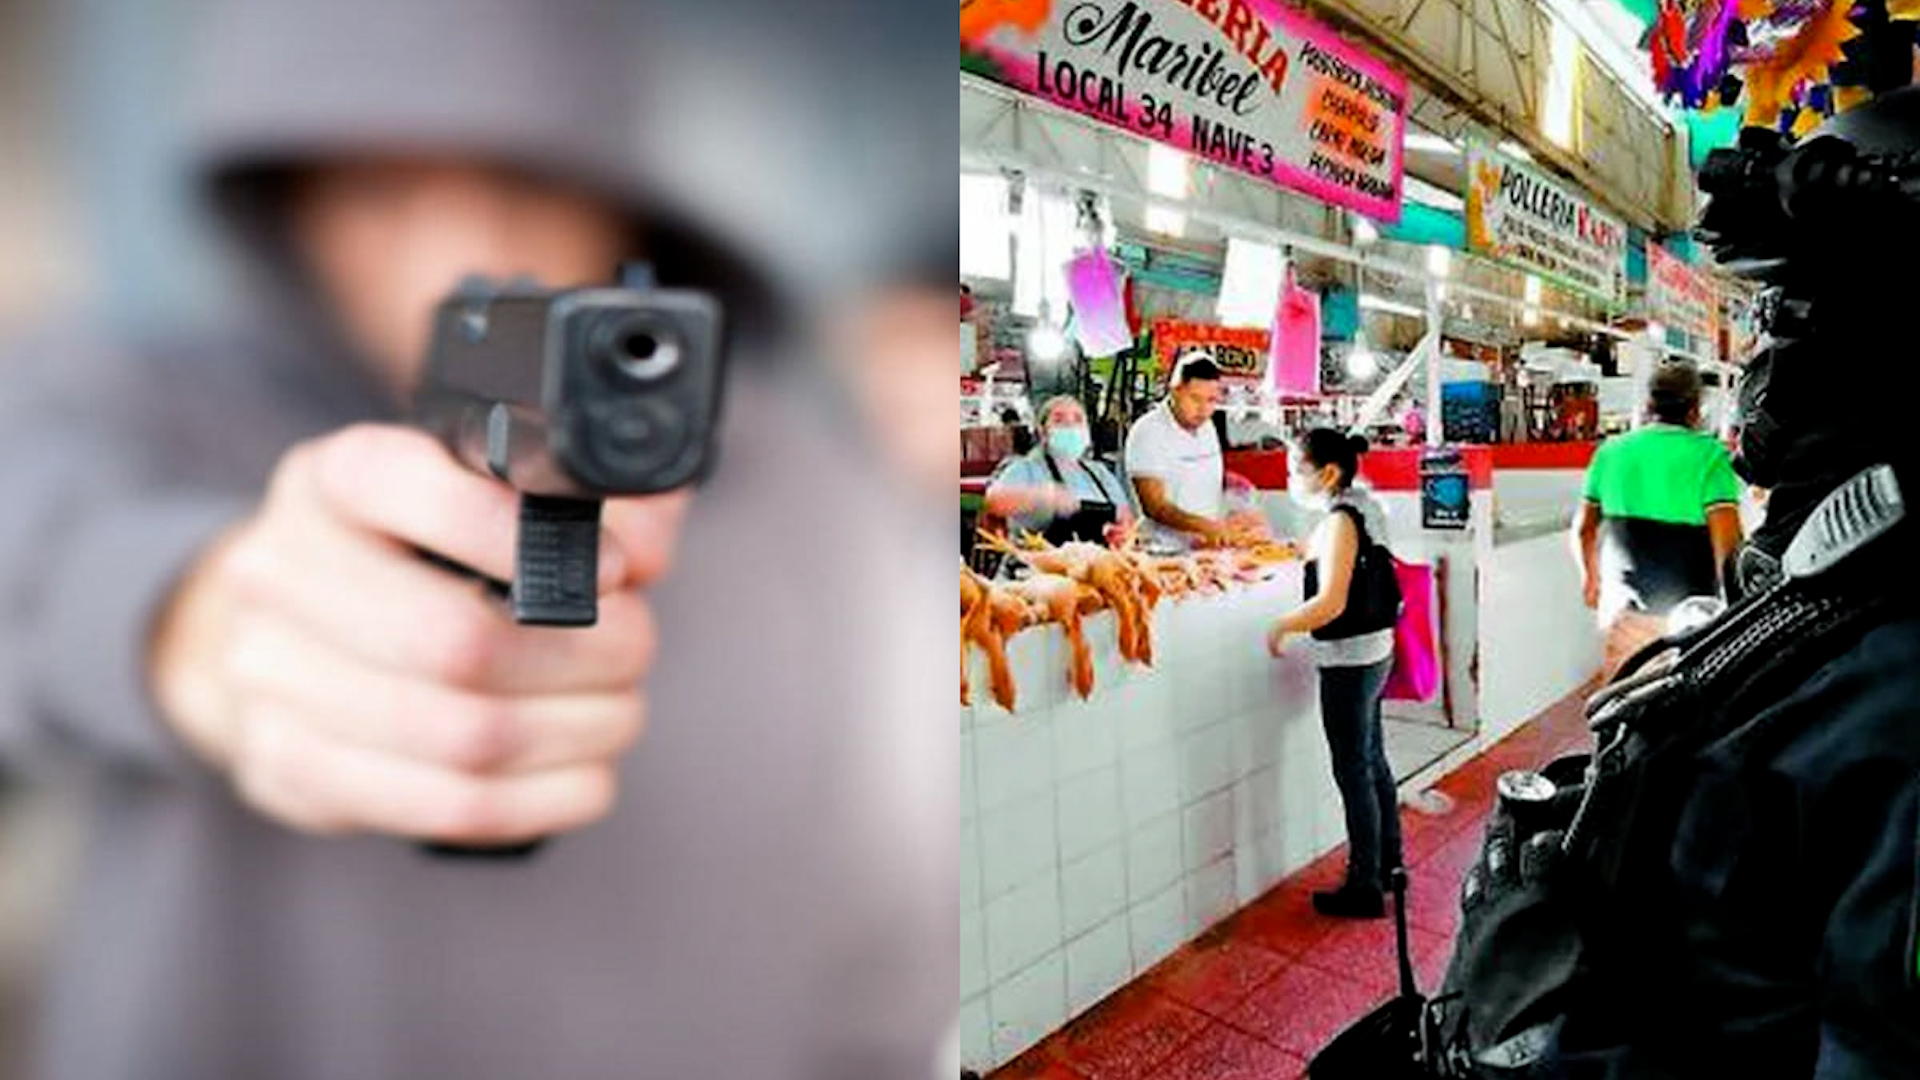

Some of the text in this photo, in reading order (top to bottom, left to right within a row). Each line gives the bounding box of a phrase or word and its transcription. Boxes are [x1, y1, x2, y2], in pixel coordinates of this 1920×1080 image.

[1037, 52, 1274, 174] LOCAL 34 NAVE 3
[1064, 2, 1266, 115] Maribel
